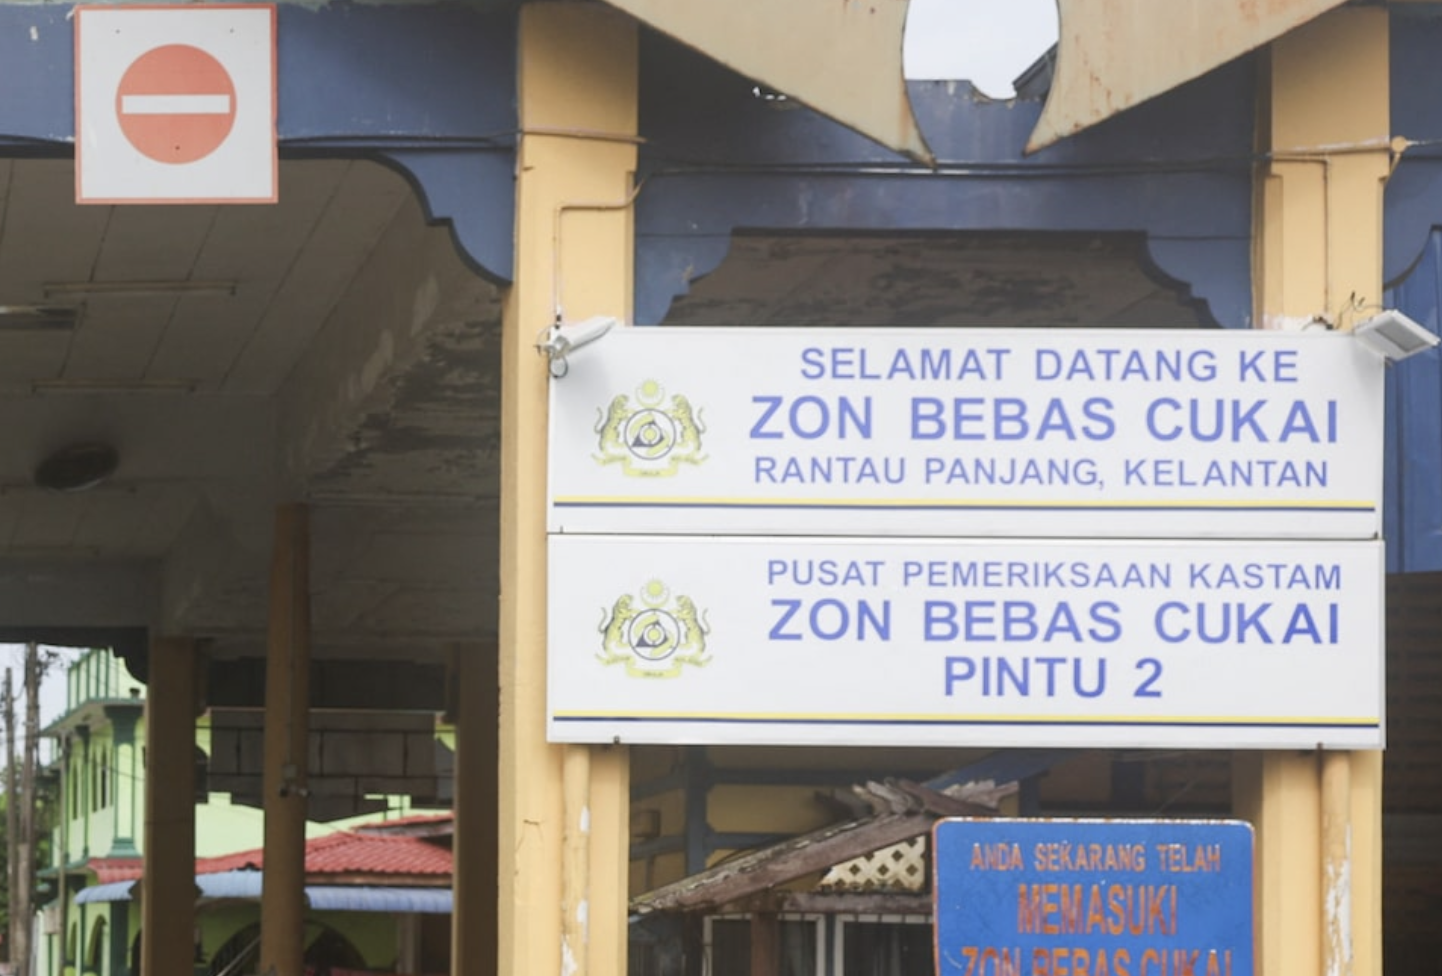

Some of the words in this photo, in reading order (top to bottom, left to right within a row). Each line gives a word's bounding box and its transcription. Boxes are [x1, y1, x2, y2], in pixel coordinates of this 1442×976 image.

[801, 348, 1011, 381] SELAMAT
[1036, 349, 1218, 382] DATANG
[1239, 350, 1298, 383] KE
[750, 395, 873, 440] ZON
[911, 396, 1117, 442] BEBAS
[1146, 397, 1338, 444] CUKAI
[754, 456, 906, 484] RANTAU
[924, 458, 1105, 491] PANJANG,
[1124, 459, 1329, 488] KELANTAN
[767, 560, 884, 587] PUSAT
[902, 561, 1172, 589] PEMERIKSAAN
[1189, 563, 1342, 590] KASTAM
[768, 598, 892, 642] ZON
[923, 600, 1123, 643] BEBAS
[1153, 601, 1340, 645] CUKAI
[944, 656, 1107, 699] PINTU
[1133, 657, 1164, 699] 2
[970, 843, 1024, 871] ANDA
[1034, 843, 1146, 872] SEKARANG
[1158, 844, 1221, 872] TELAH
[1017, 884, 1177, 936] MEMASUKI
